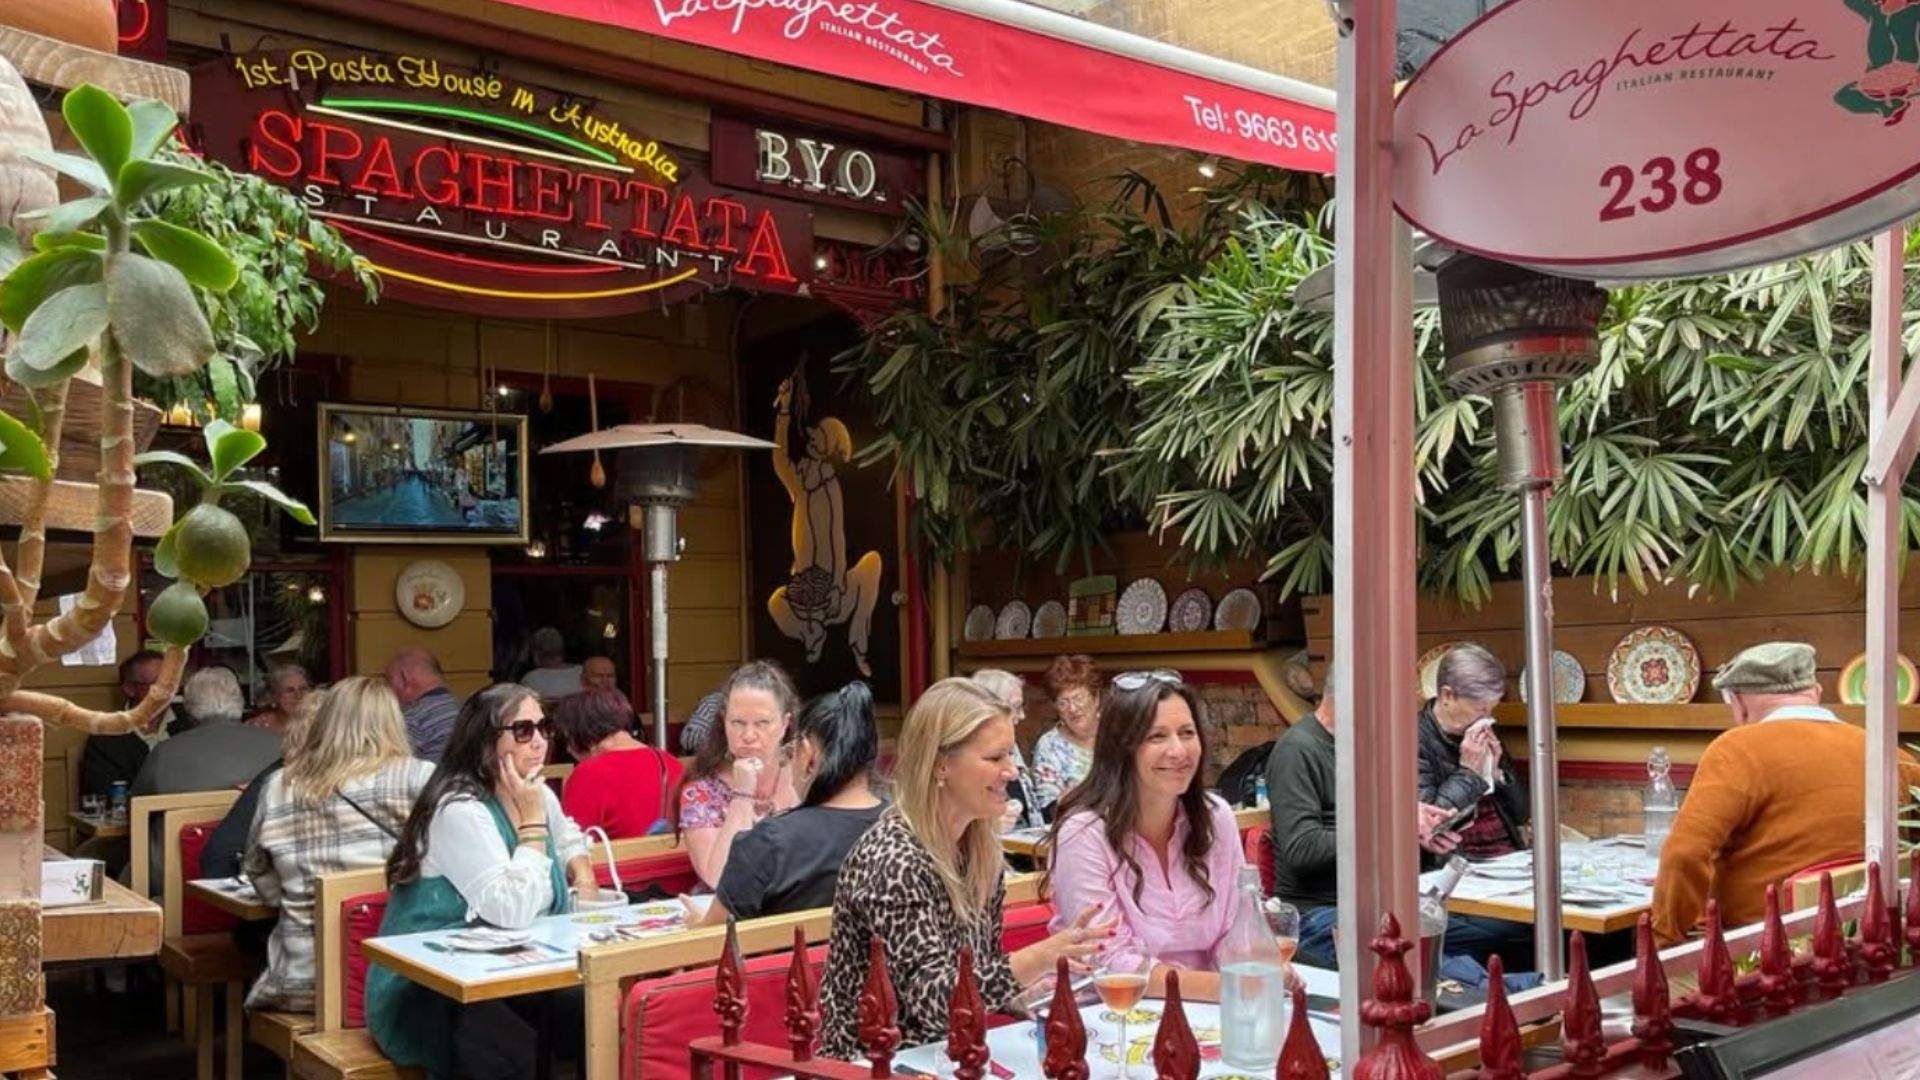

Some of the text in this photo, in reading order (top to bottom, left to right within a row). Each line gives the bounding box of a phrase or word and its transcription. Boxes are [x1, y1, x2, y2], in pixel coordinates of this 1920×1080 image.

[712, 0, 966, 78] pghettata
[819, 20, 930, 74] ITALIAN RESTAURANT
[290, 49, 396, 84] Pasta
[397, 55, 502, 99] House
[549, 101, 679, 184] Australia
[1416, 17, 1837, 176] La Spaghettata
[1615, 66, 1776, 92] ITALIAN RESTAURANT
[1183, 94, 1234, 135] Tel:
[1234, 108, 1299, 149] 9663
[251, 109, 798, 283] SPAGHETTATA
[1599, 146, 1724, 223] 238
[302, 184, 724, 273] STAURANT
